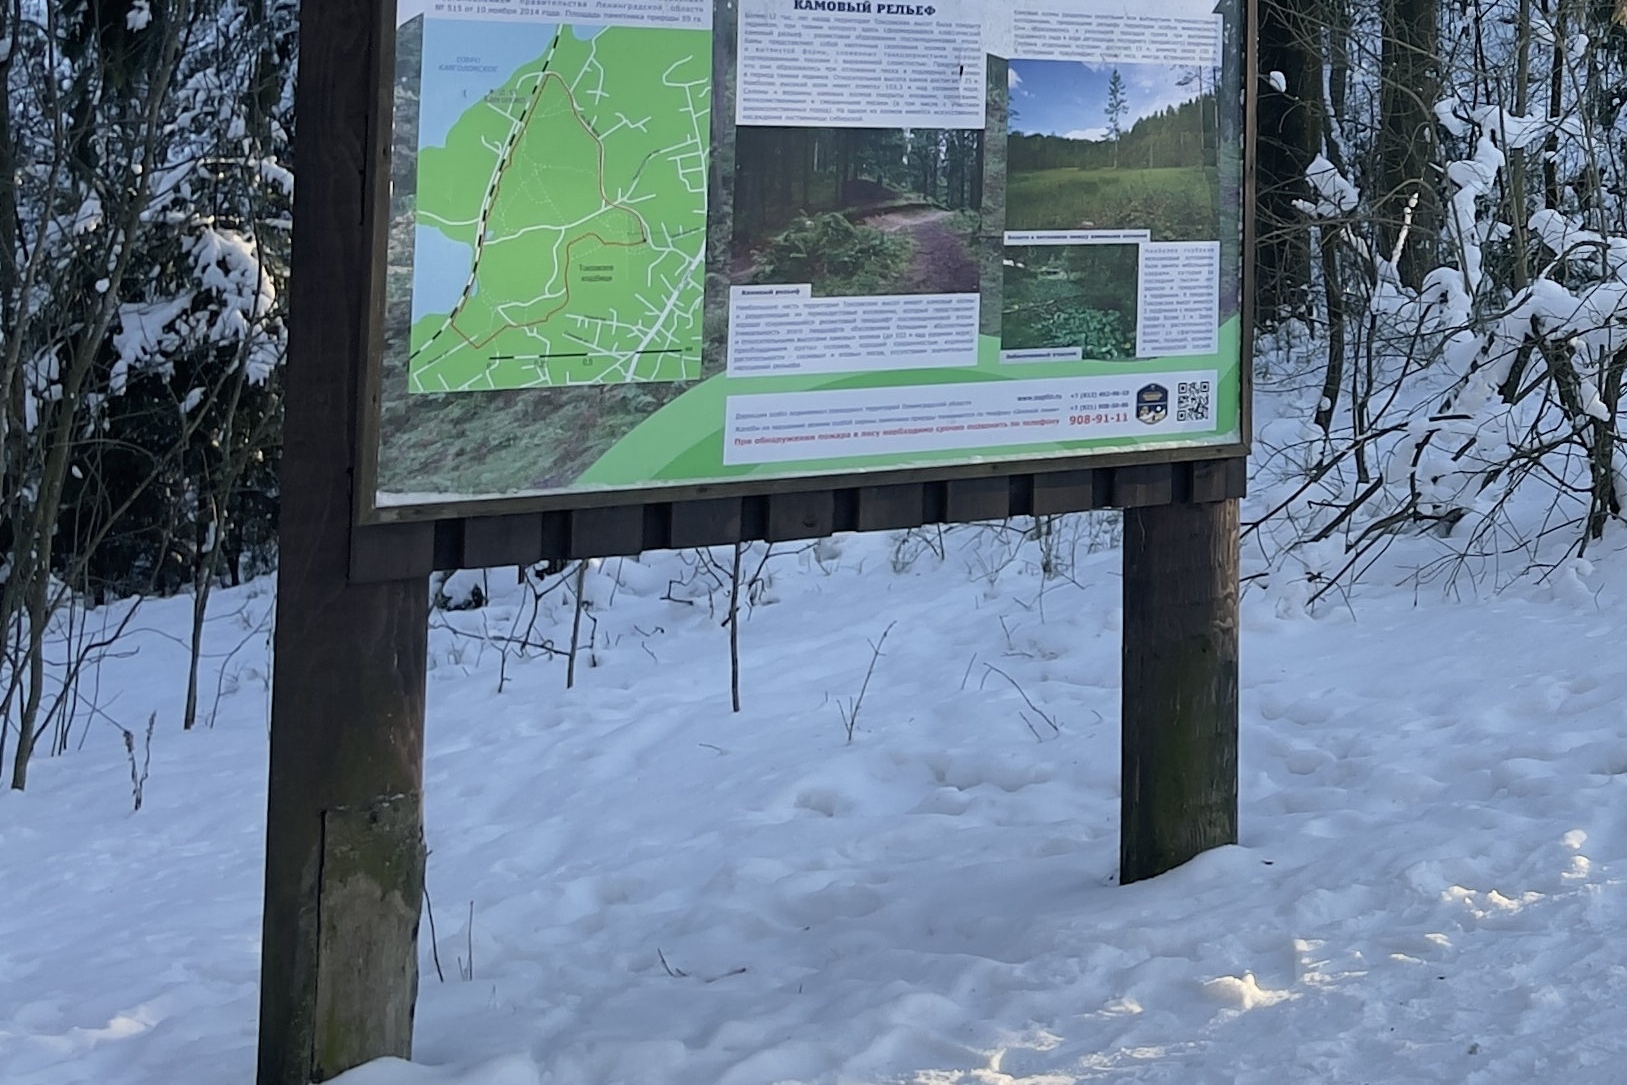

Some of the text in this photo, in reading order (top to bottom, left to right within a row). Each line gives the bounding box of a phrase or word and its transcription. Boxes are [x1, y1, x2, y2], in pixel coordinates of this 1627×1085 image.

[476, 5, 487, 14] 10
[876, 3, 937, 17] РЕЛЬЕФ
[1069, 411, 1129, 426] 908-91-11
